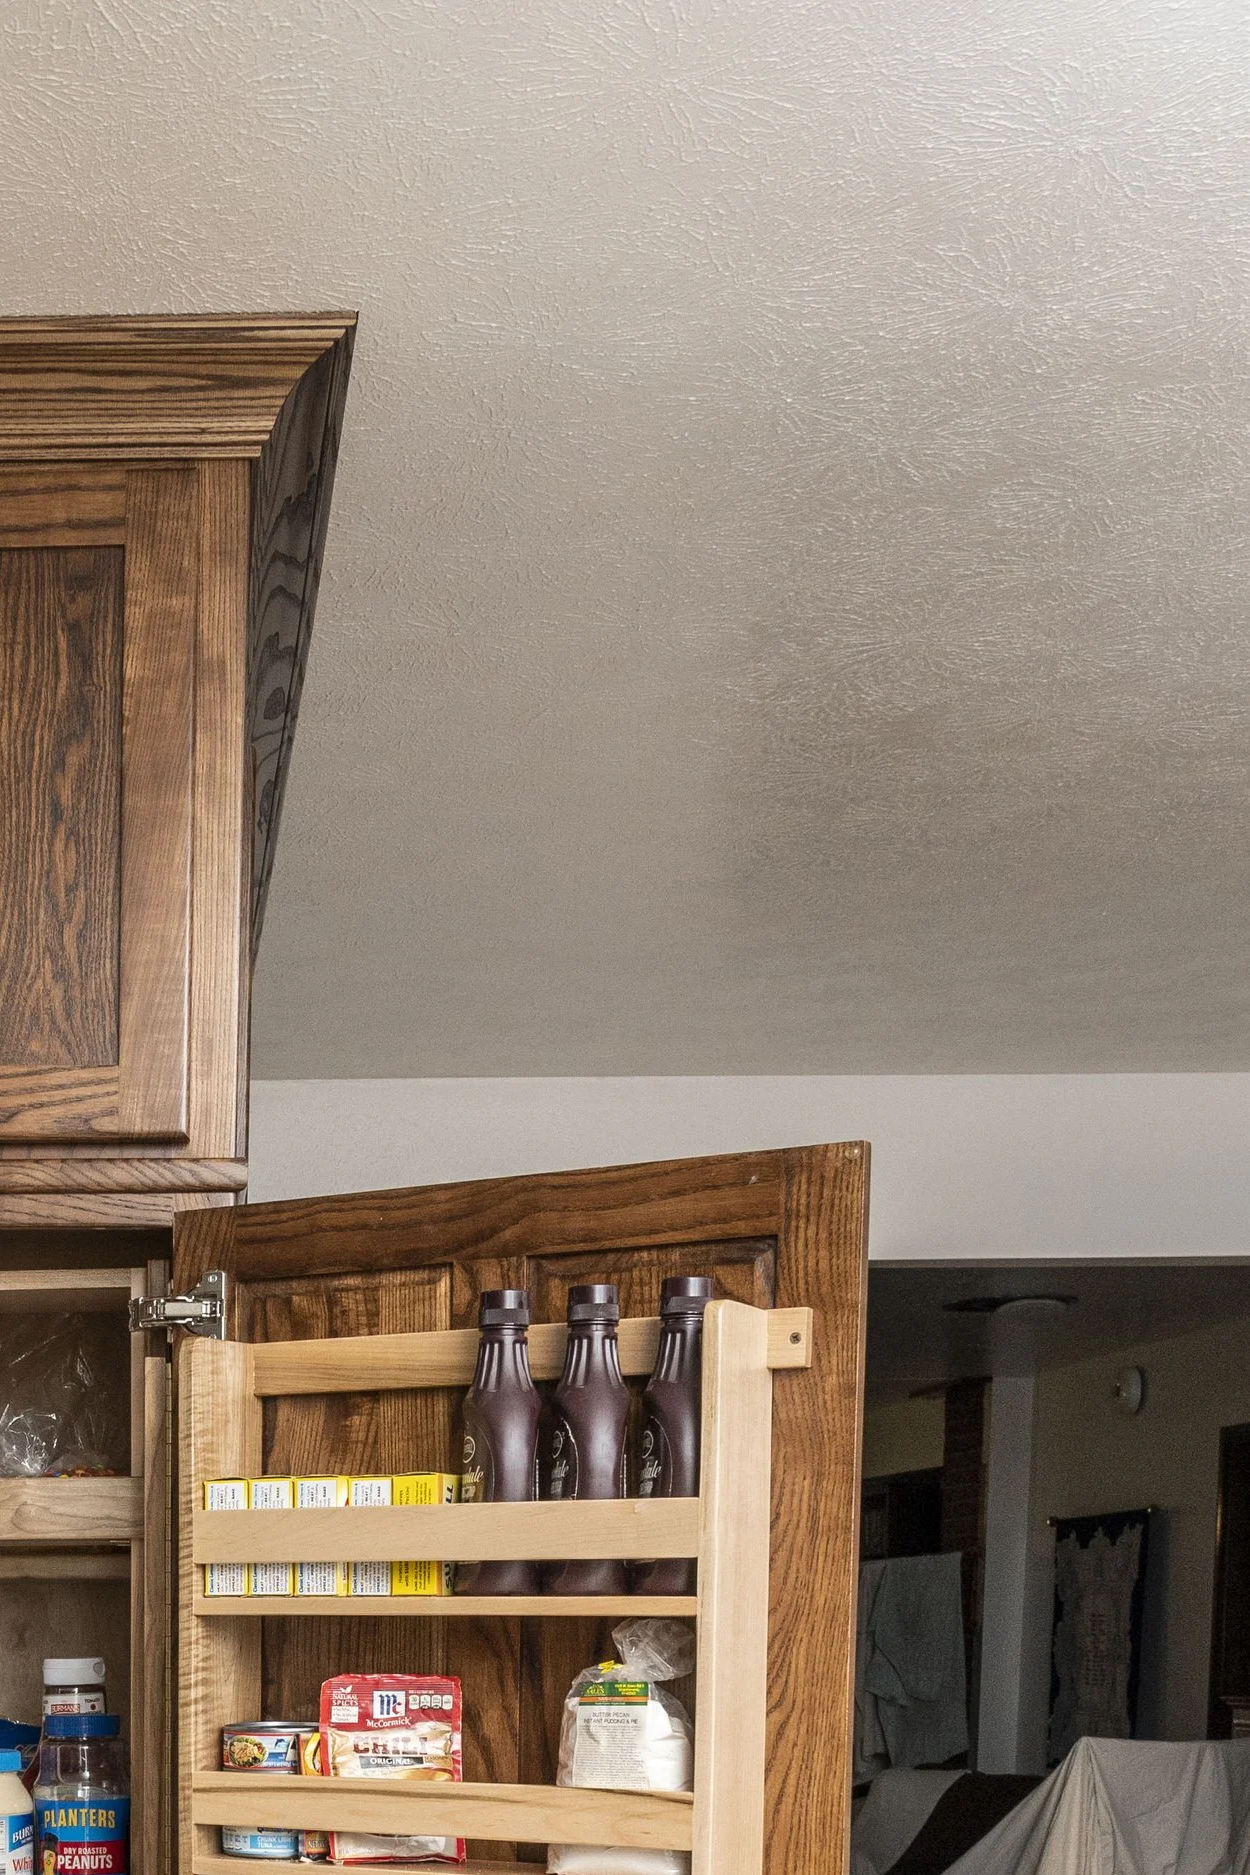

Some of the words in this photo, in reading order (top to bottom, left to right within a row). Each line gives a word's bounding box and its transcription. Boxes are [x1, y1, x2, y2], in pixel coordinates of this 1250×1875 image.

[366, 1718, 410, 1728] McCormick
[370, 1758, 411, 1766] ORIGINAL
[44, 1808, 116, 1828] PLANTERS
[63, 1847, 78, 1855] DRY
[78, 1846, 108, 1854] ROASTED
[57, 1854, 113, 1870] PEANUTS
